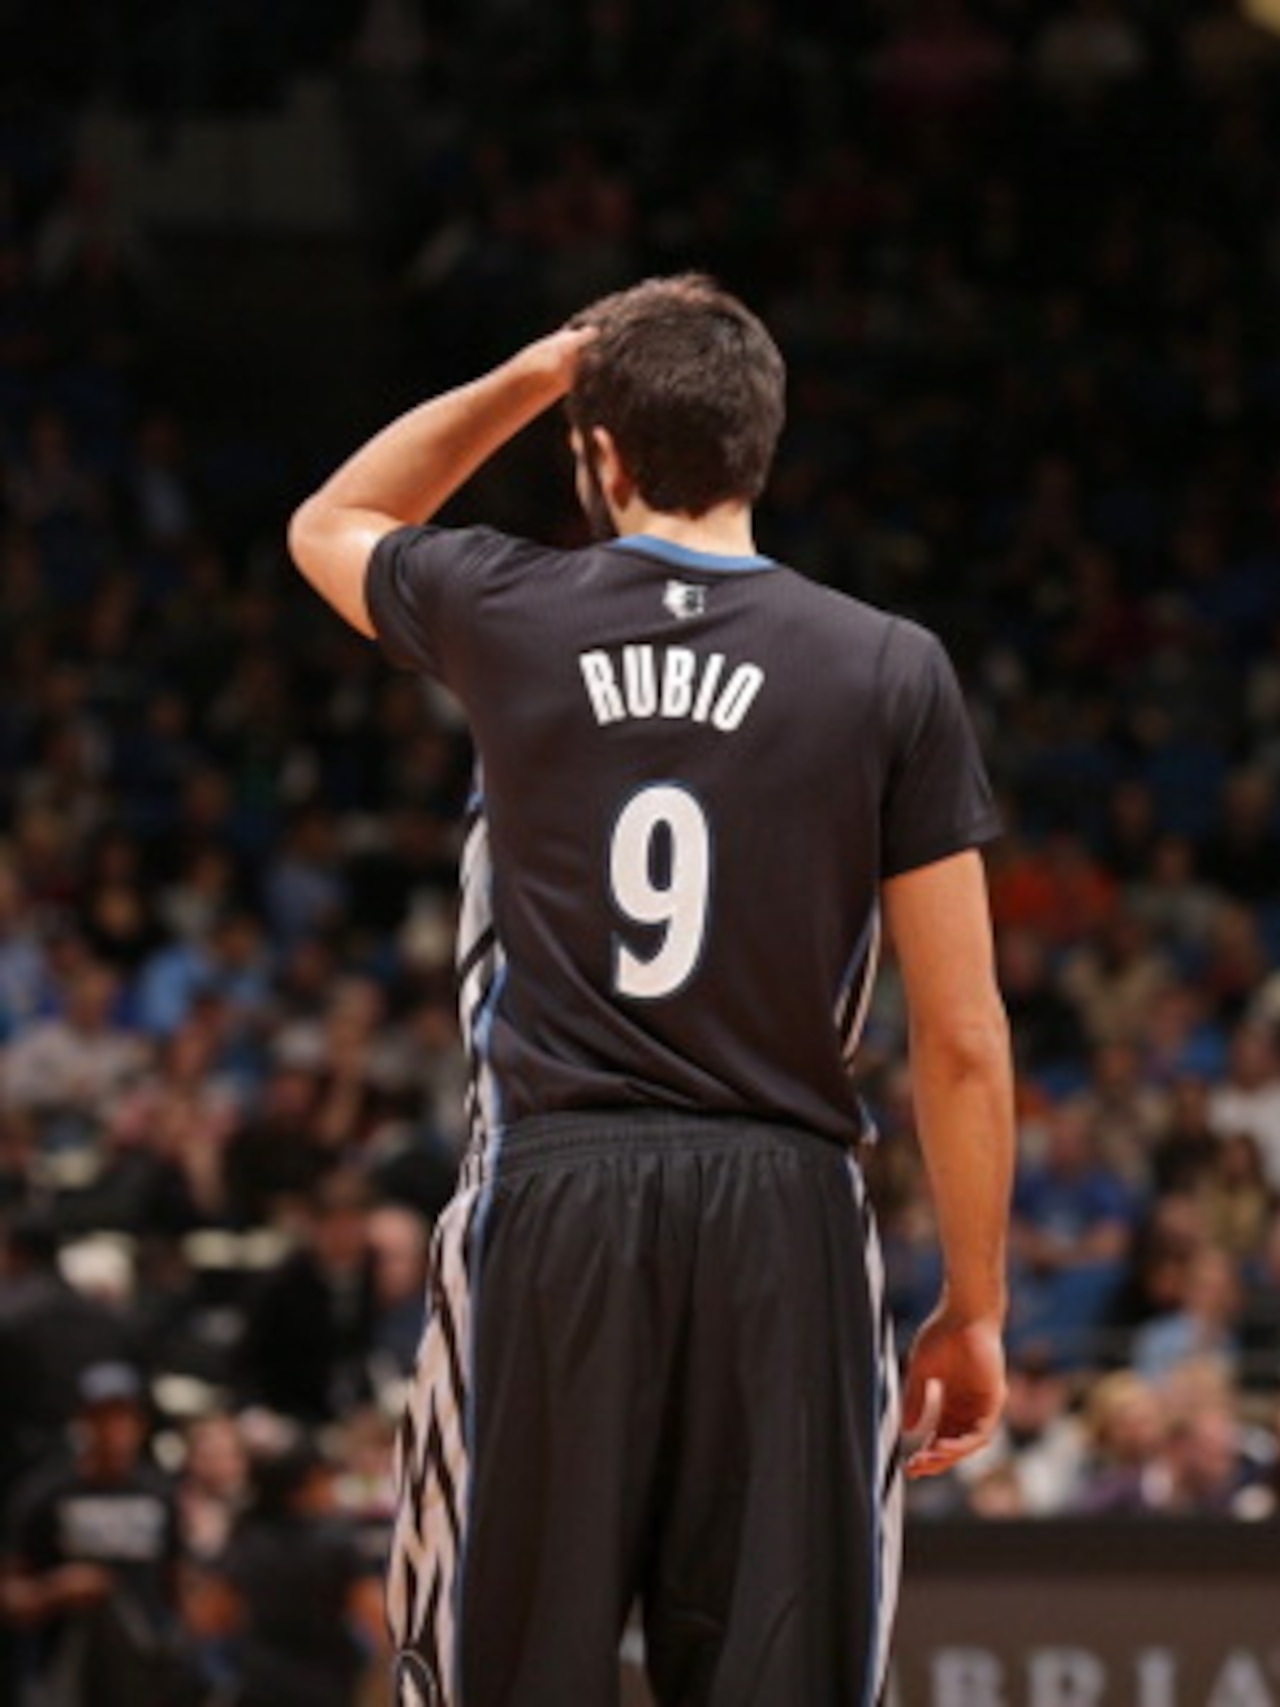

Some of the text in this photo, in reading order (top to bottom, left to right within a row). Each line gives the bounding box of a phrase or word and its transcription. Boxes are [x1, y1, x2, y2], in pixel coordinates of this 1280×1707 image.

[579, 643, 765, 732] RUBIO
[609, 784, 713, 1000] 9
[885, 1647, 1276, 1707] BRIA
